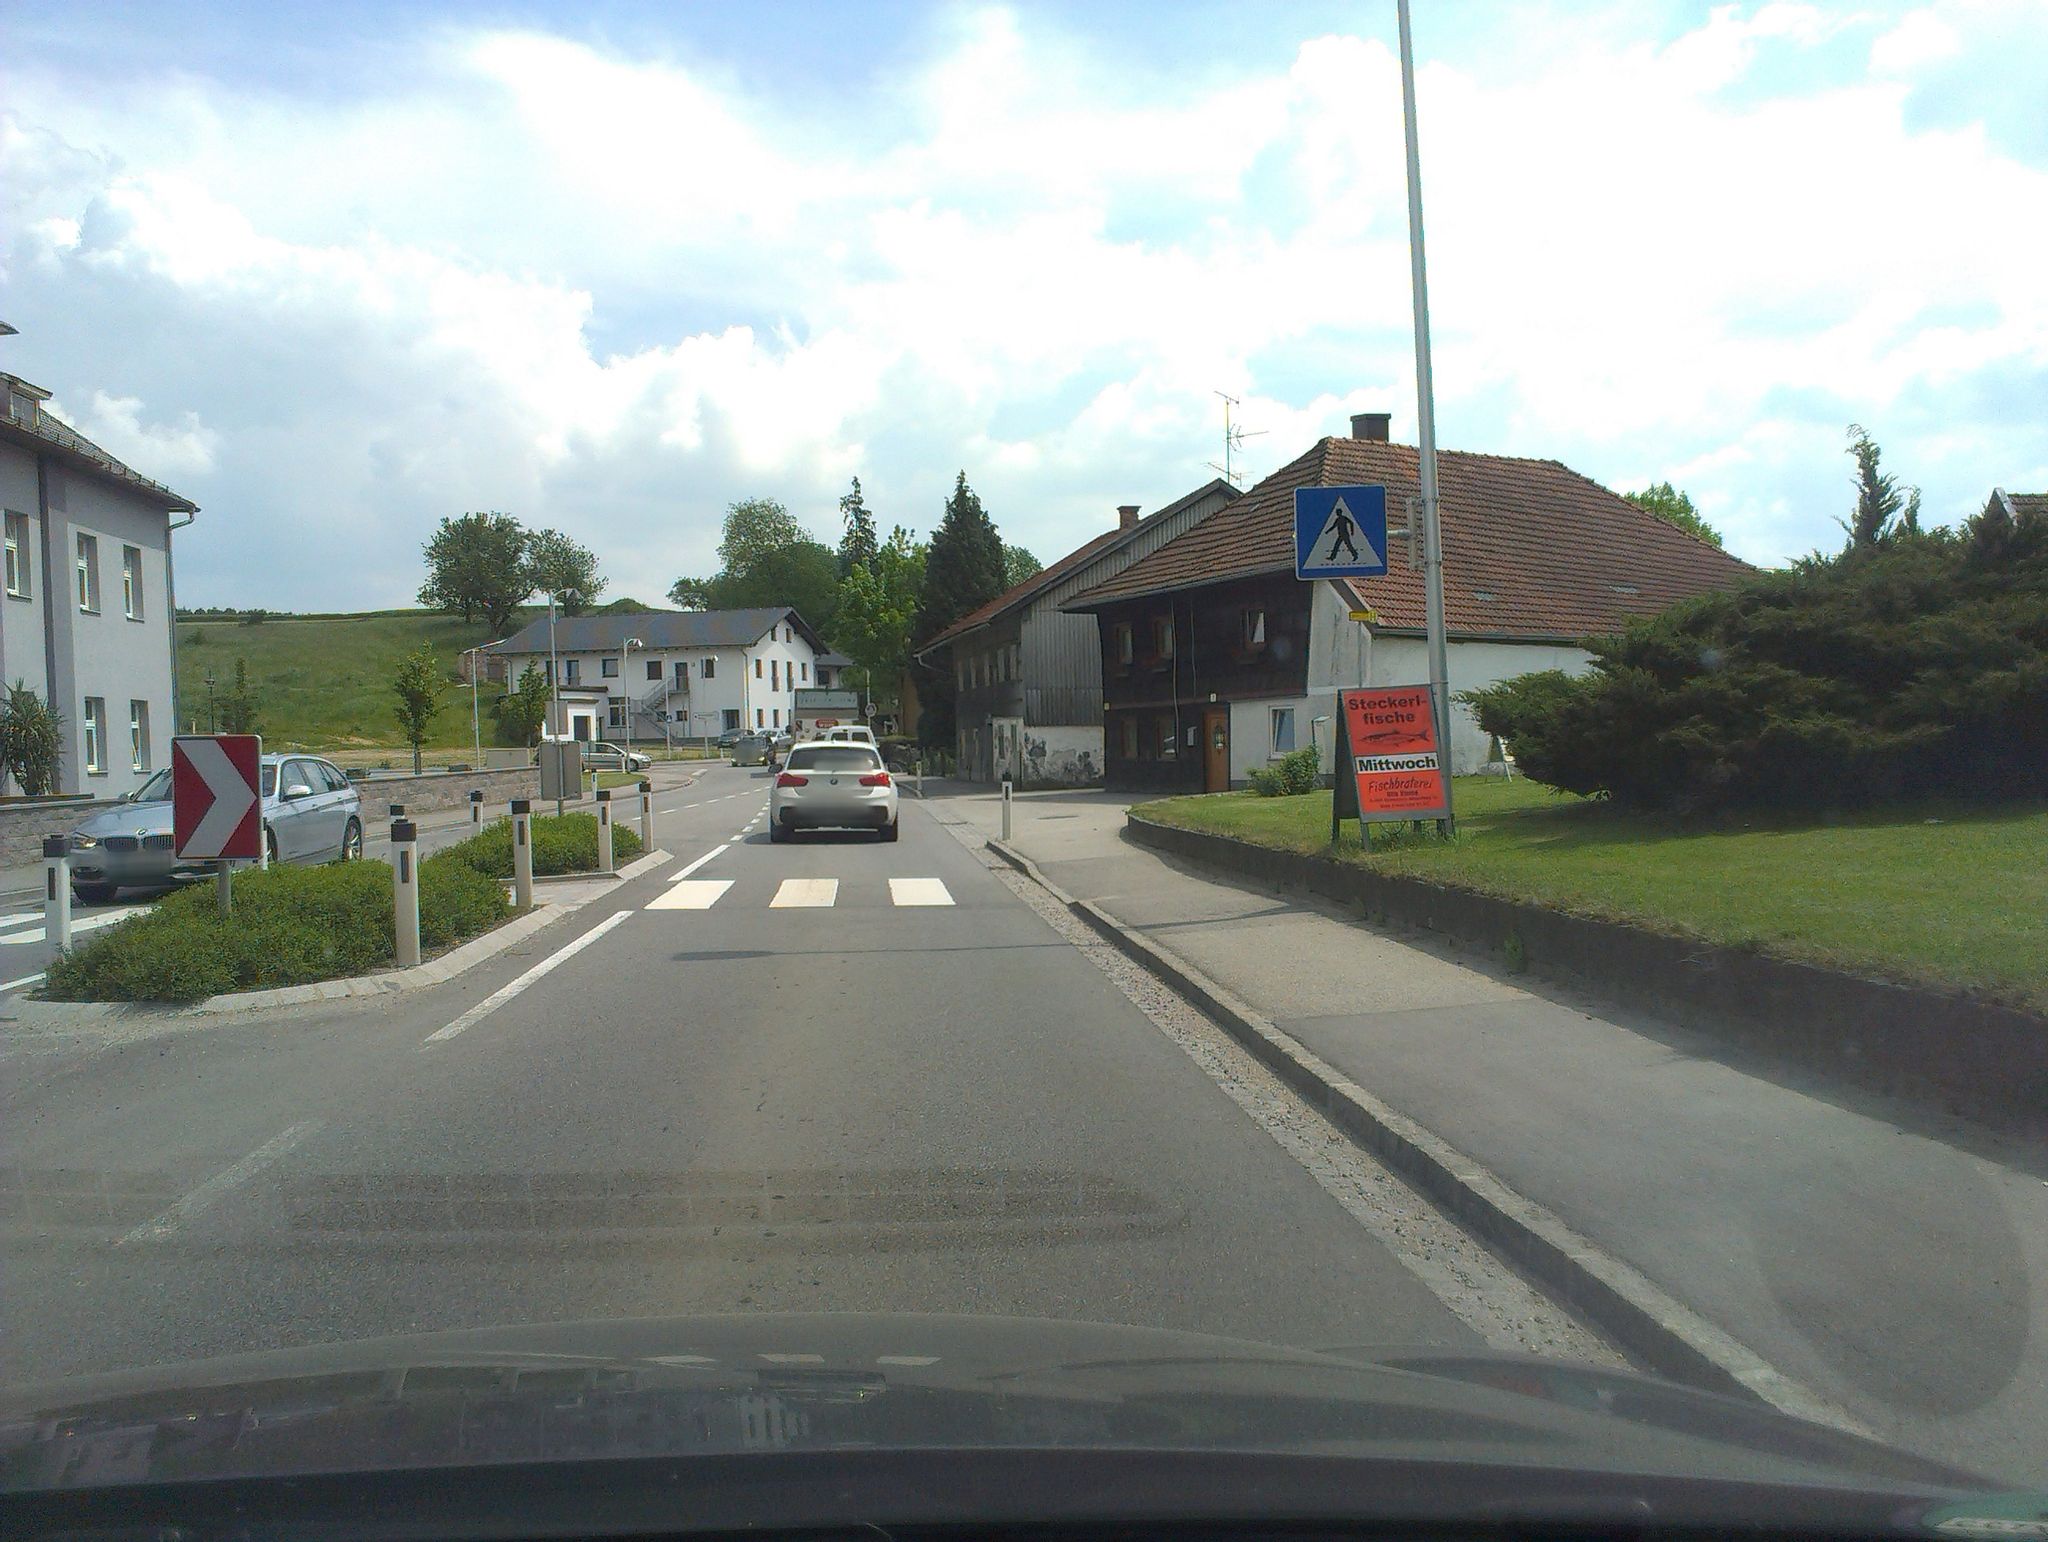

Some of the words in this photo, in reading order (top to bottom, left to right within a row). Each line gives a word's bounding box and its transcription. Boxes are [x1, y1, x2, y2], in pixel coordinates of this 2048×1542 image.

[1363, 711, 1416, 725] fische
[1358, 756, 1436, 772] Mittwoch
[1368, 775, 1433, 792] Fischbraterei
